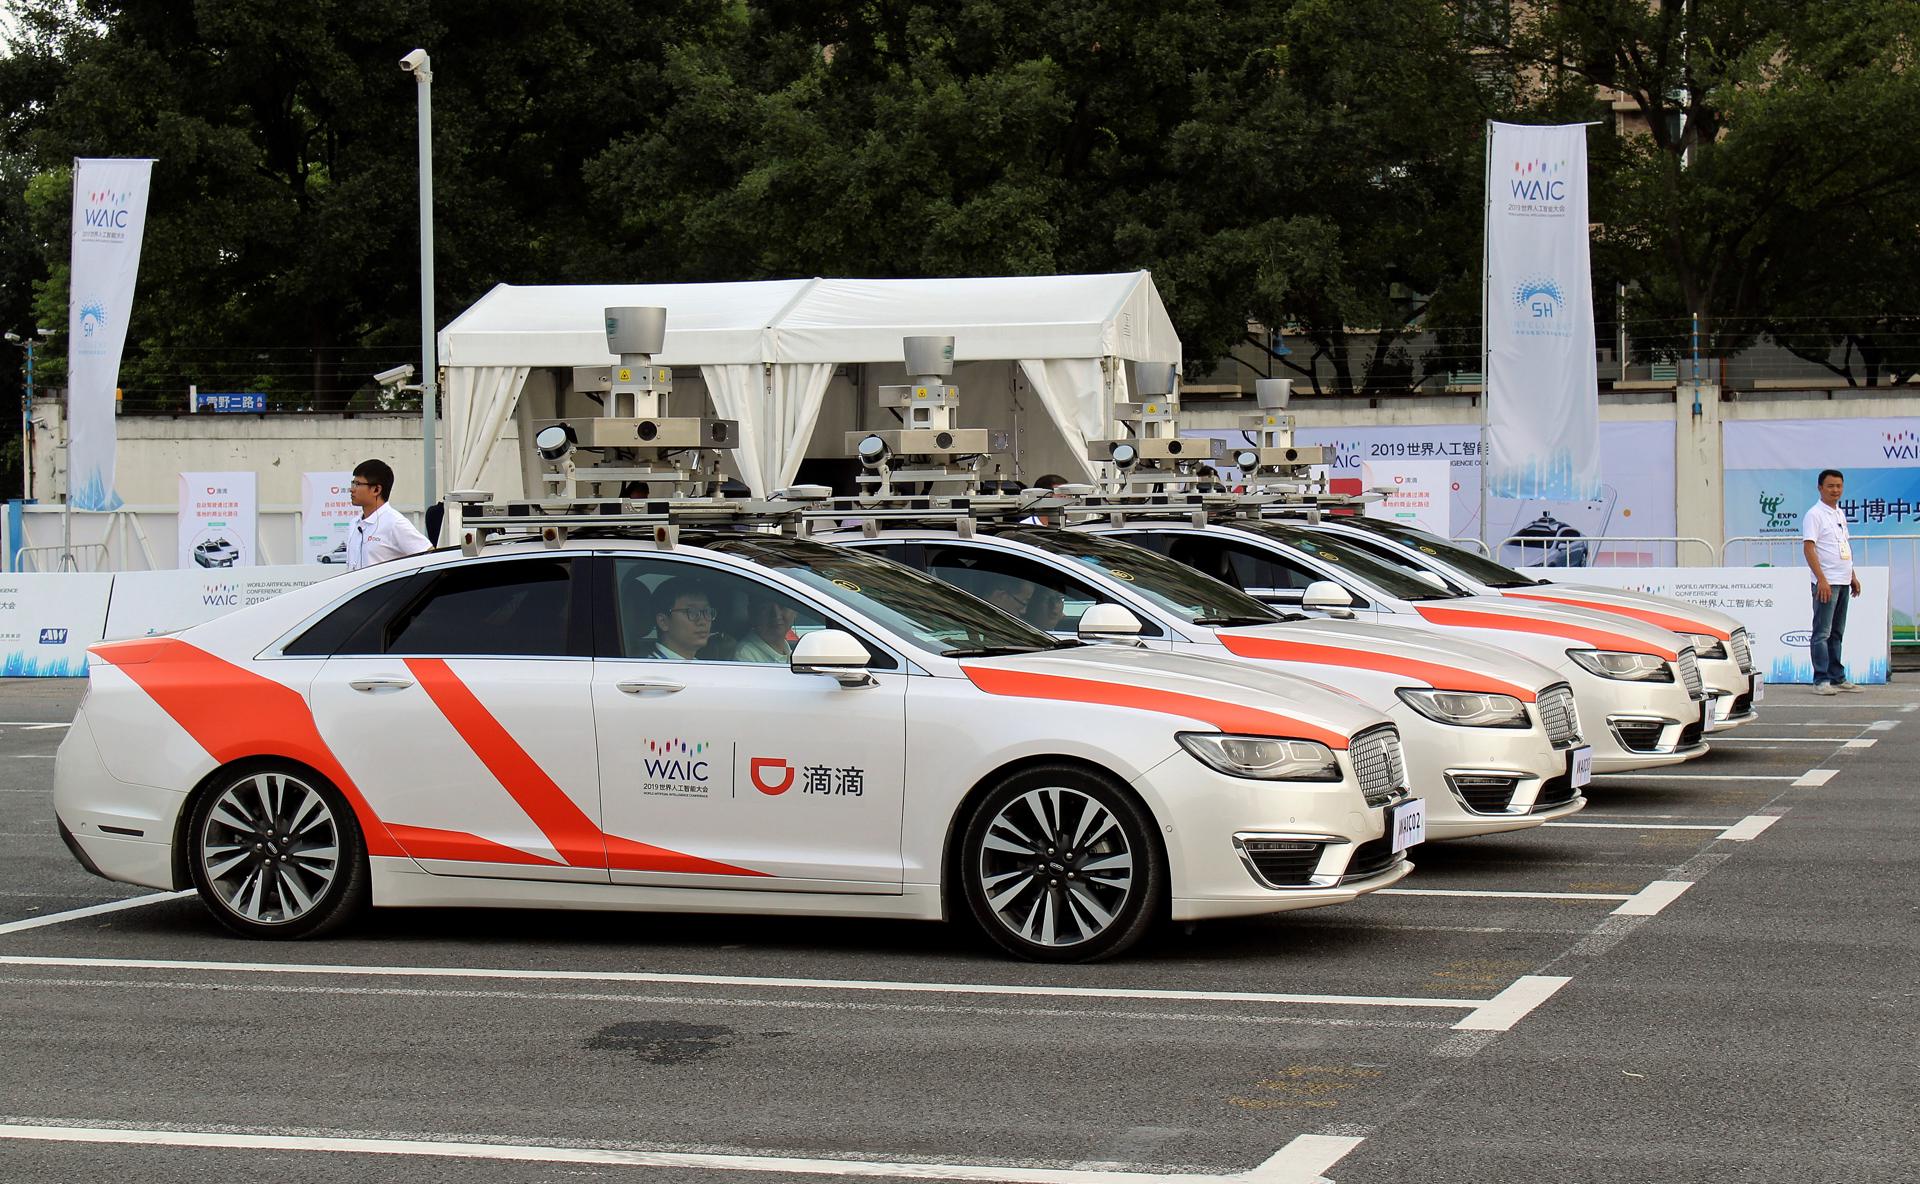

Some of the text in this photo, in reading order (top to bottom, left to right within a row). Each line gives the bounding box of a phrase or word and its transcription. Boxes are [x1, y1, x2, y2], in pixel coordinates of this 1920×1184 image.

[1511, 179, 1565, 201] WAIC
[85, 208, 128, 228] WAIC
[1532, 302, 1553, 318] SH
[1332, 455, 1361, 468] AIC
[1883, 446, 1920, 459] WAI
[203, 595, 238, 605] WAIC
[644, 759, 709, 782] WAIC
[802, 764, 864, 797] 滴滴
